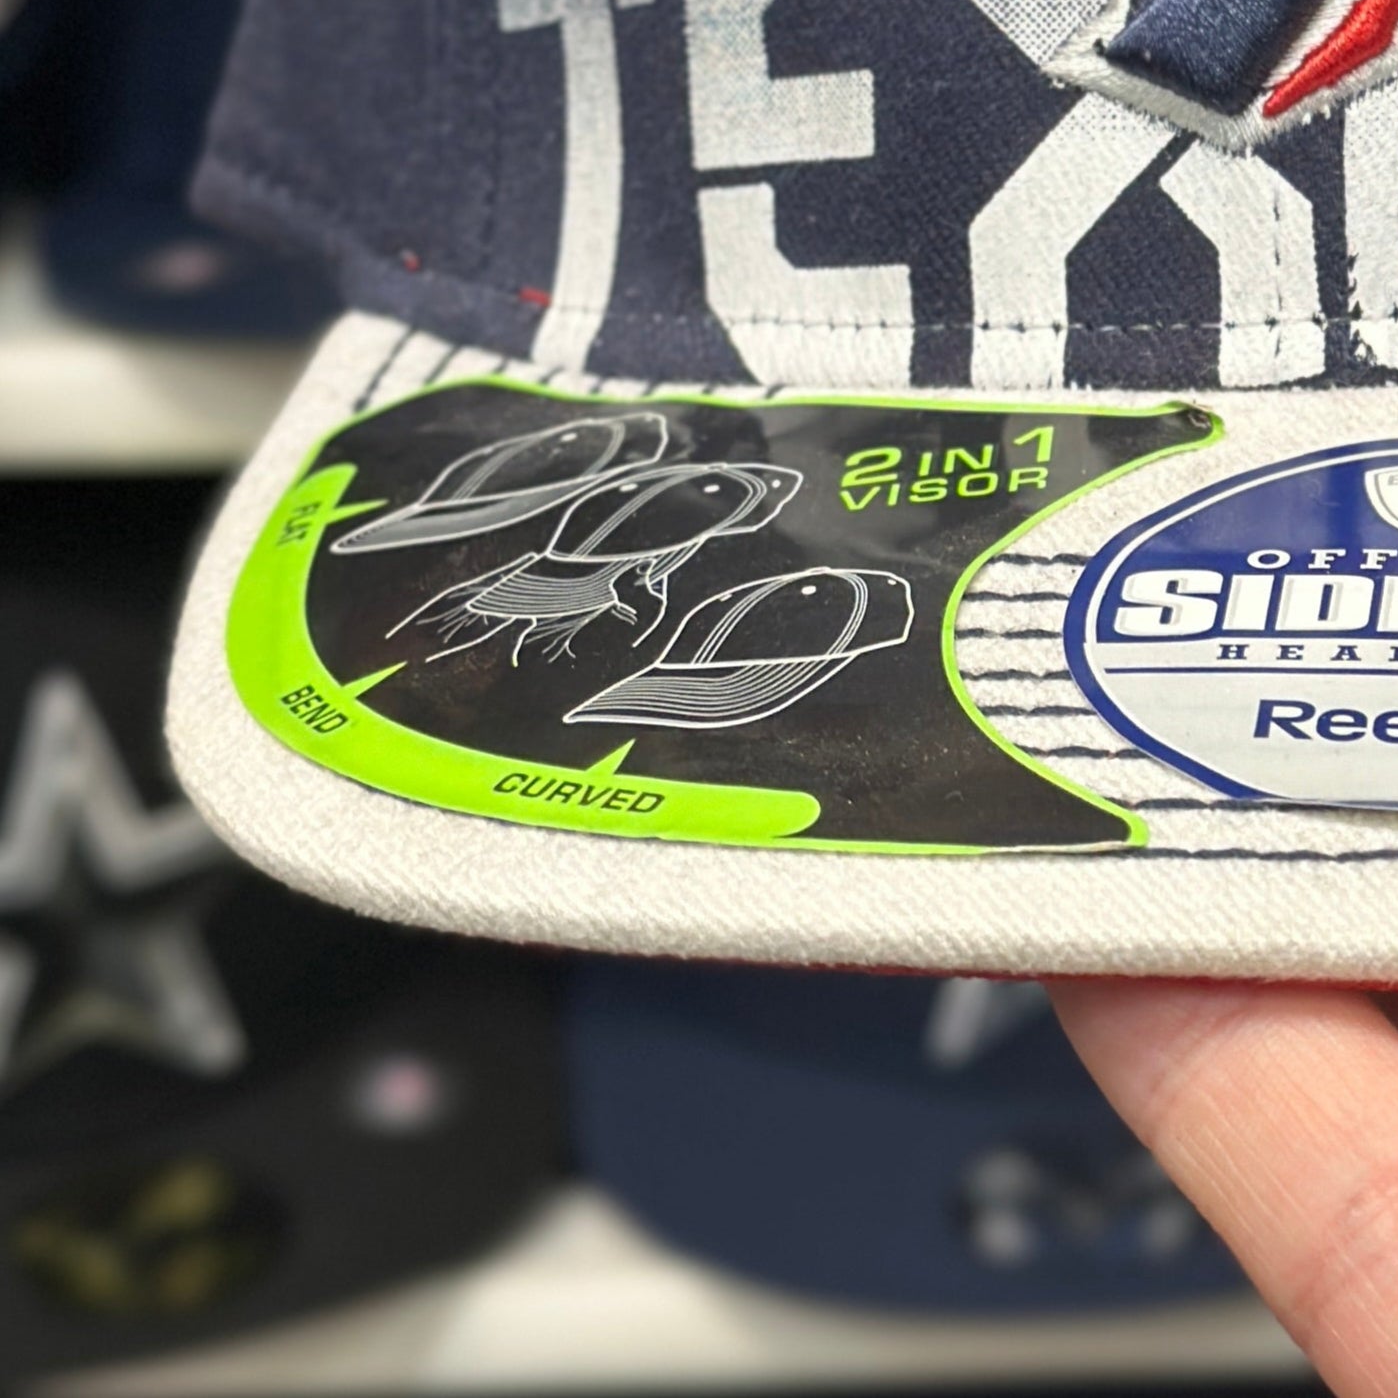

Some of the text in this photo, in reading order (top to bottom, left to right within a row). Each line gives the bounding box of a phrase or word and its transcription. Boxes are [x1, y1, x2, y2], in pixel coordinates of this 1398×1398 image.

[841, 426, 1055, 487] 2 IN 1
[840, 467, 1048, 511] VISOR
[277, 501, 320, 547] FLAT
[280, 684, 349, 734] BEND
[493, 772, 665, 815] CURVED
